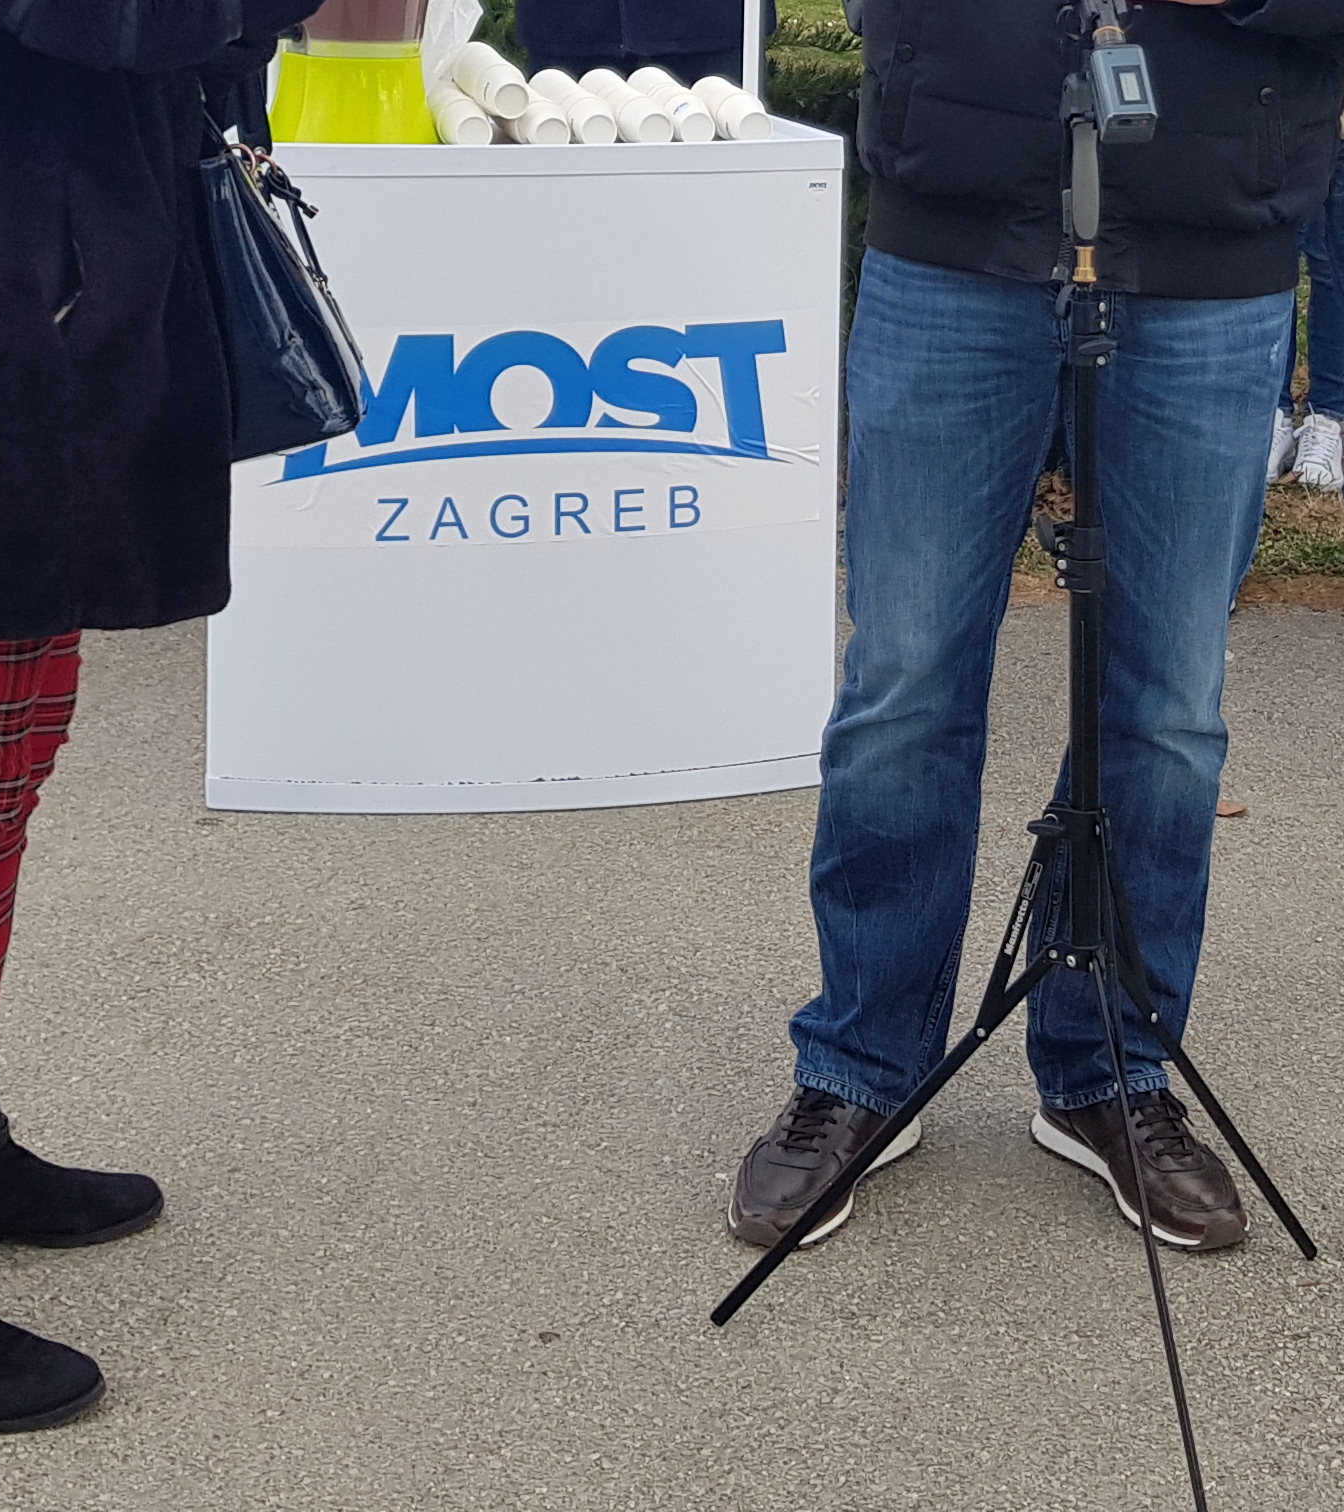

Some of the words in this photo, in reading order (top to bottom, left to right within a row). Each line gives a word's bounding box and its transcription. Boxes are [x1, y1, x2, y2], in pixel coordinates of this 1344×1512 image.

[282, 319, 787, 480] MOST
[375, 485, 702, 542] ZAGREB
[1003, 899, 1029, 956] Manfrotto
